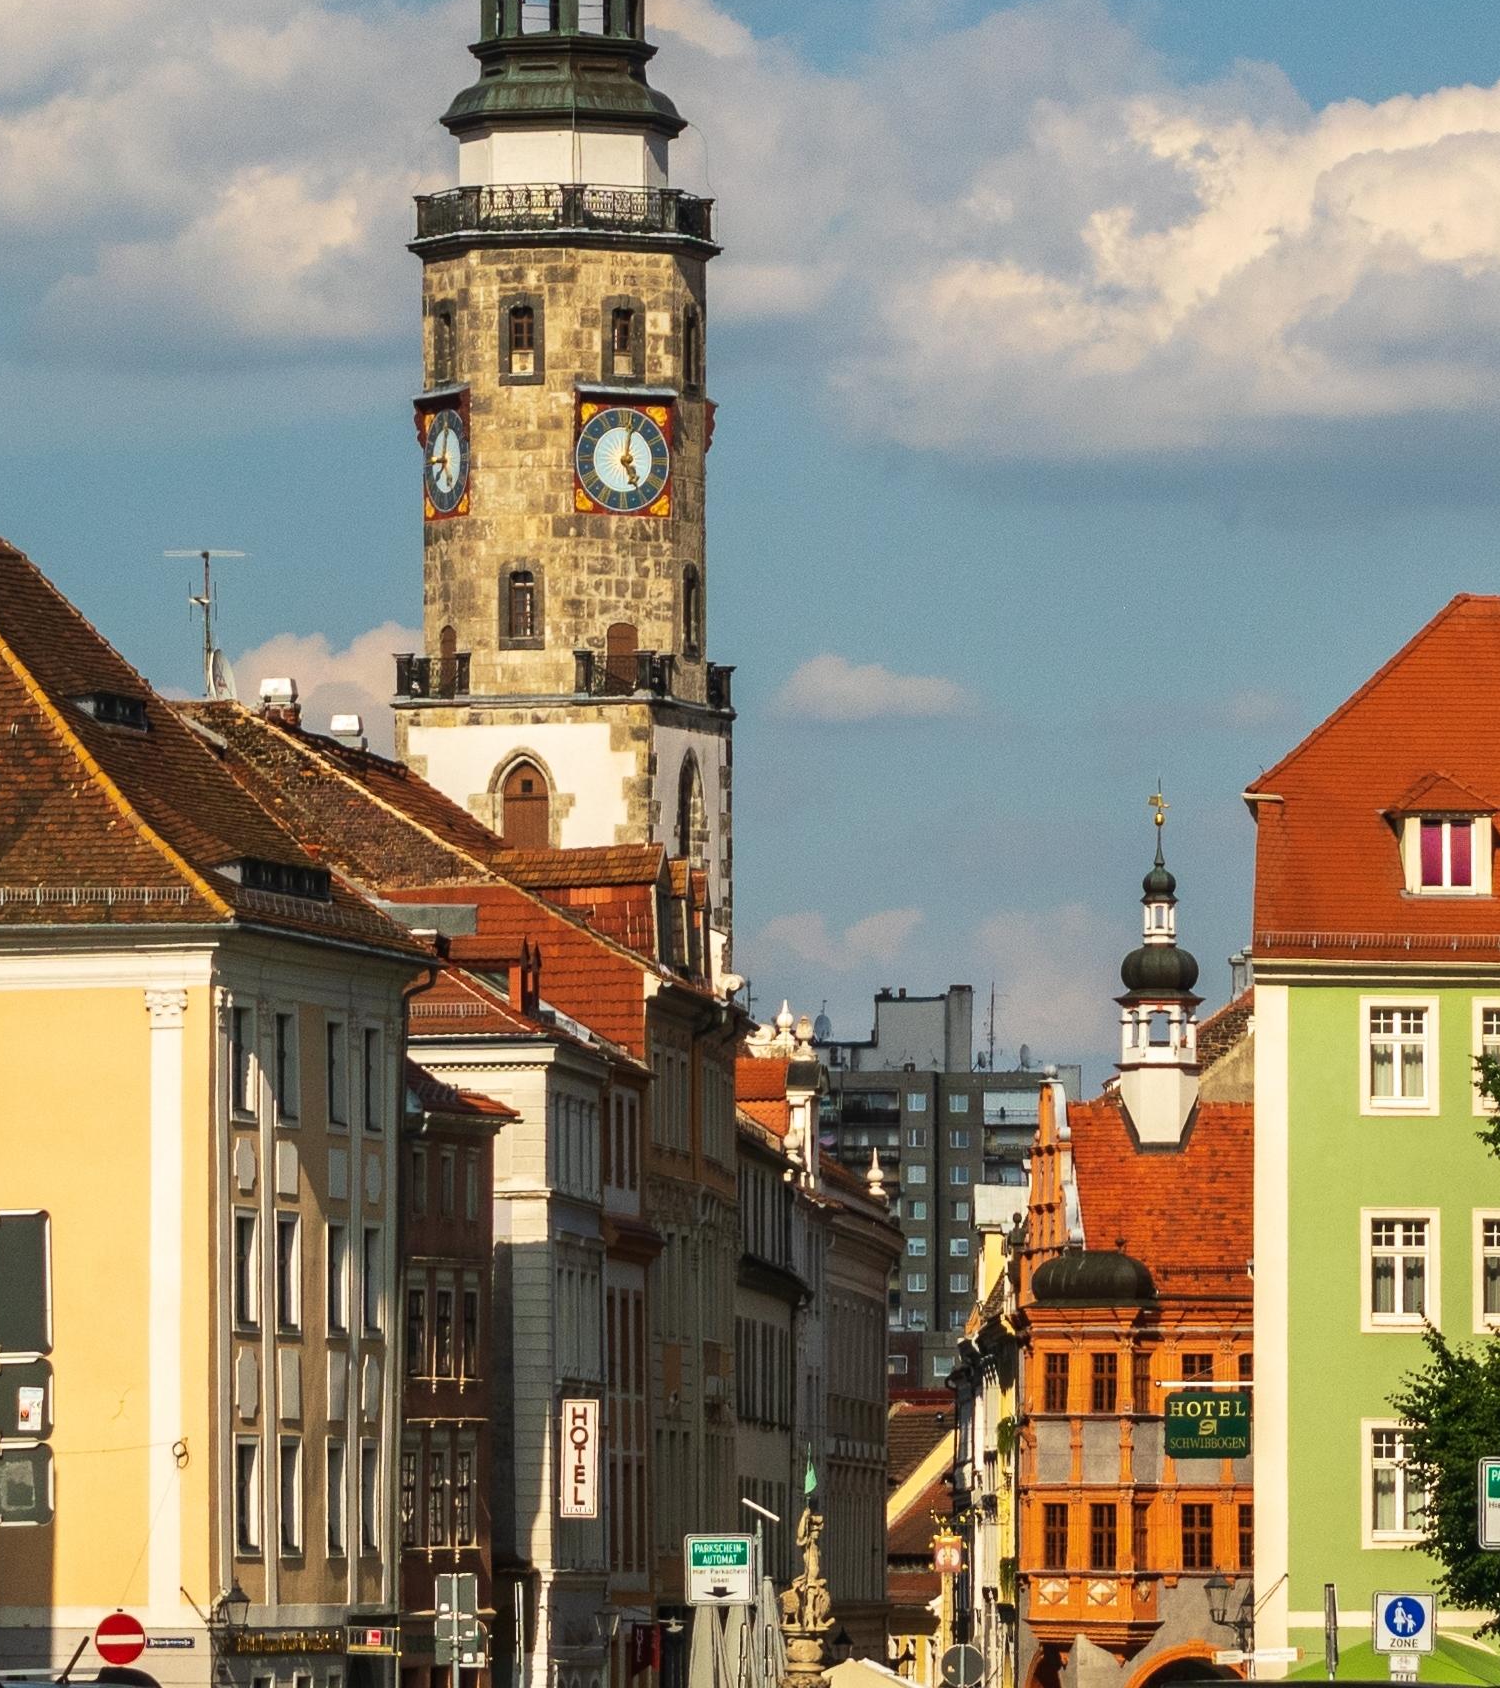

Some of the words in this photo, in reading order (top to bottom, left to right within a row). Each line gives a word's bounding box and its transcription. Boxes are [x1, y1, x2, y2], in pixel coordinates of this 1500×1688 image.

[1169, 1400, 1246, 1417] HOTEL
[1170, 1437, 1246, 1449] SCHWIBBOGEN
[570, 1407, 589, 1505] HOTEL
[694, 1543, 745, 1553] PARKSCHEIN-
[702, 1554, 737, 1564] AUTOMAT
[1390, 1639, 1418, 1648] ZONE
